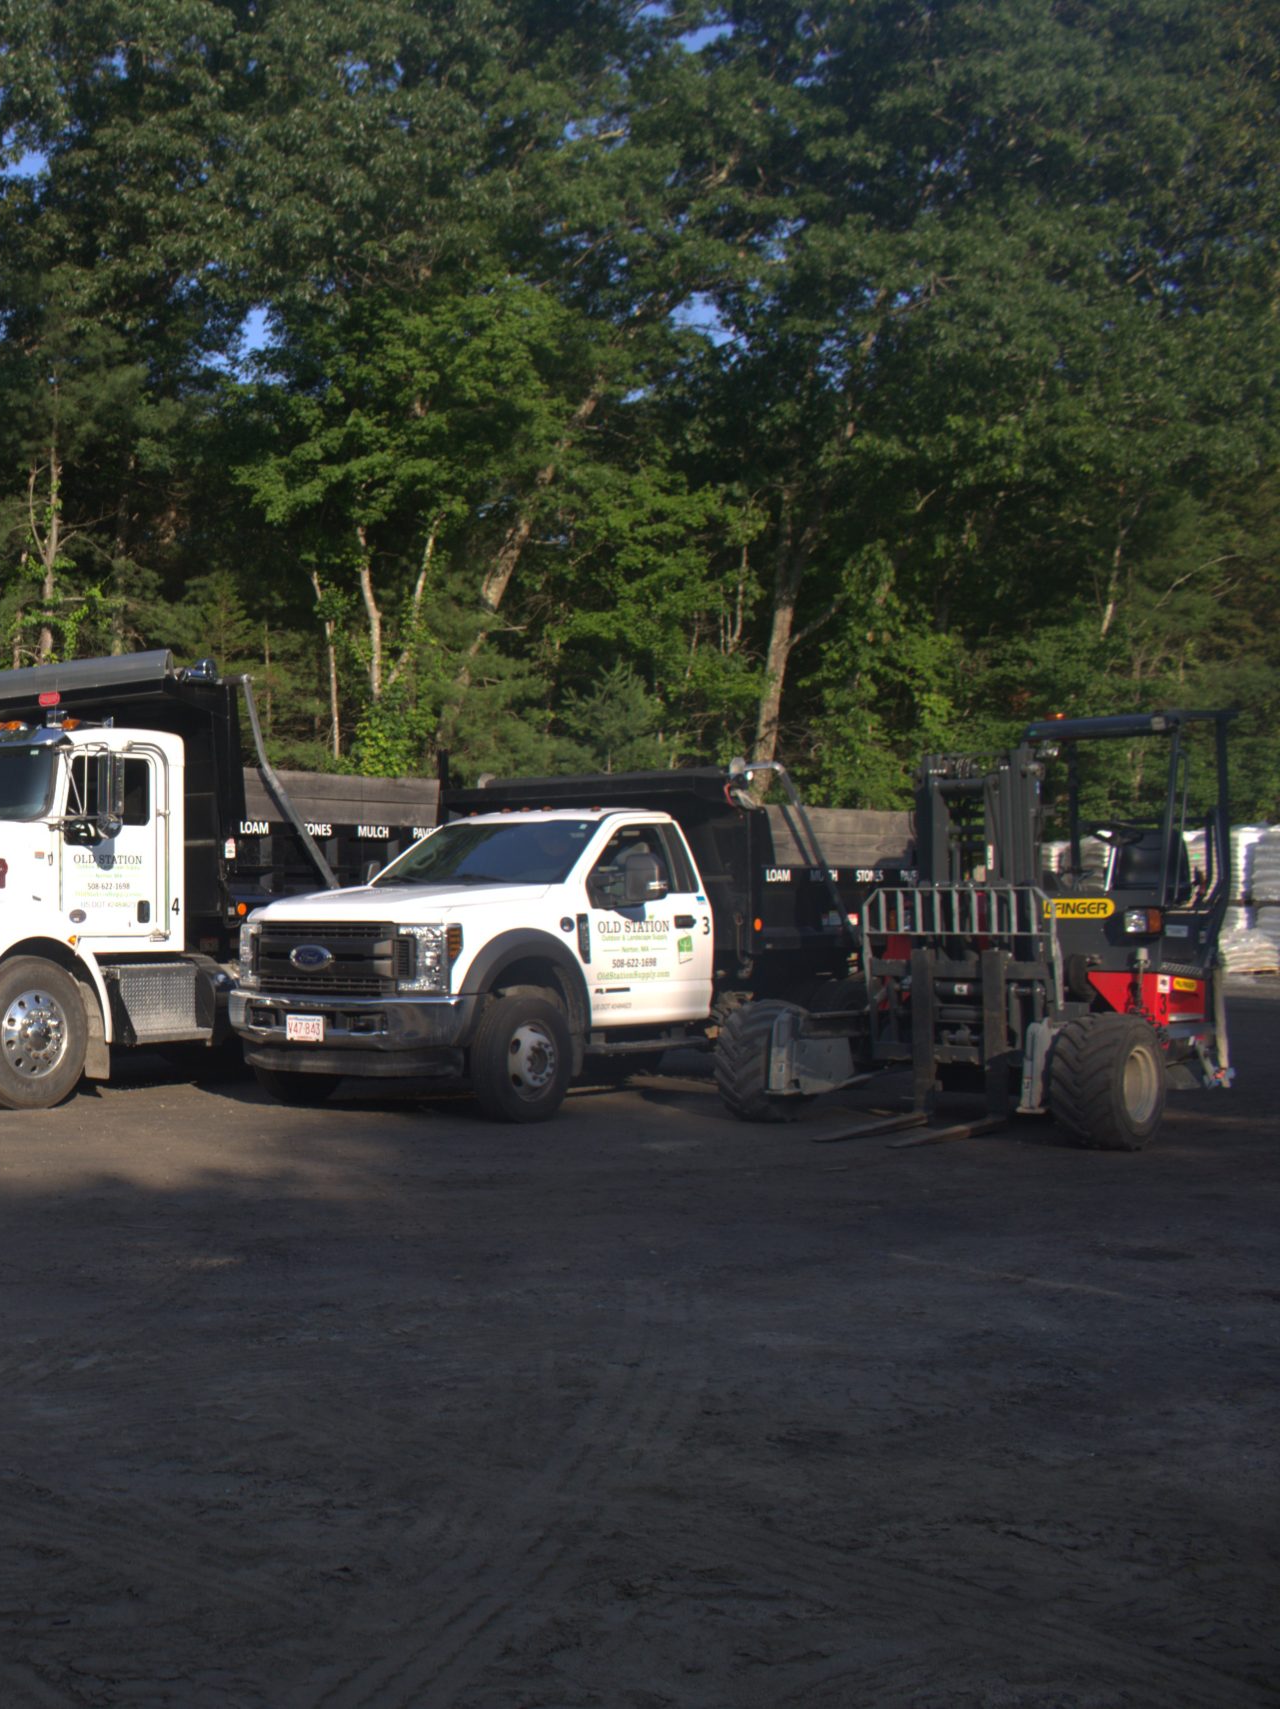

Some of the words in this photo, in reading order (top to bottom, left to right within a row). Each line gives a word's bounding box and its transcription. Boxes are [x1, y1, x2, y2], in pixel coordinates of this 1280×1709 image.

[240, 821, 269, 835] LOAM
[358, 825, 389, 838] MULCH
[73, 854, 96, 864] OLD
[99, 855, 142, 864] STATION
[765, 869, 791, 882] LOAM
[171, 897, 180, 915] 4
[1045, 902, 1108, 915] LFINGER
[597, 920, 621, 934] OLD
[624, 920, 670, 933] STATION
[702, 916, 710, 935] 3
[612, 957, 657, 969] 508-622-1698
